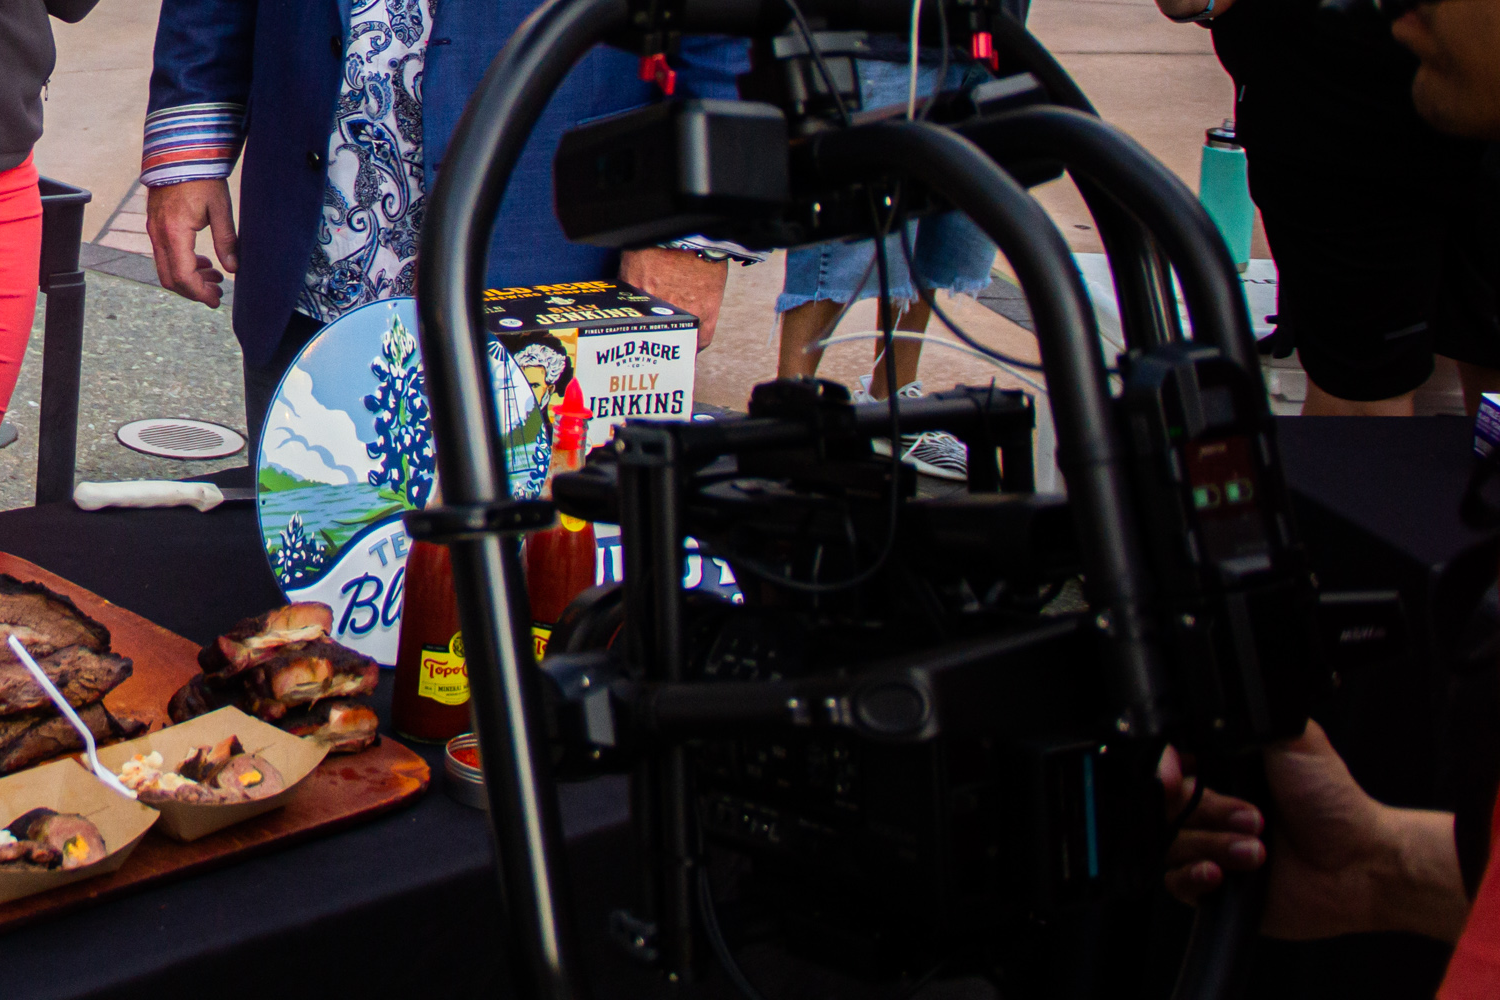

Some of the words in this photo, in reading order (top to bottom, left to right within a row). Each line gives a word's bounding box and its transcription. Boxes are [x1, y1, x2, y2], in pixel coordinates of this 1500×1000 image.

[483, 287, 534, 298] ILD
[533, 280, 617, 292] ACRE
[536, 307, 645, 326] JENKINS
[547, 304, 600, 314] BILLY
[596, 341, 636, 365] WILD
[638, 340, 680, 361] ACRE
[616, 356, 658, 367] BREWING
[609, 373, 659, 393] BILLY
[589, 389, 684, 421] JENKINS
[423, 657, 460, 679] Topo
